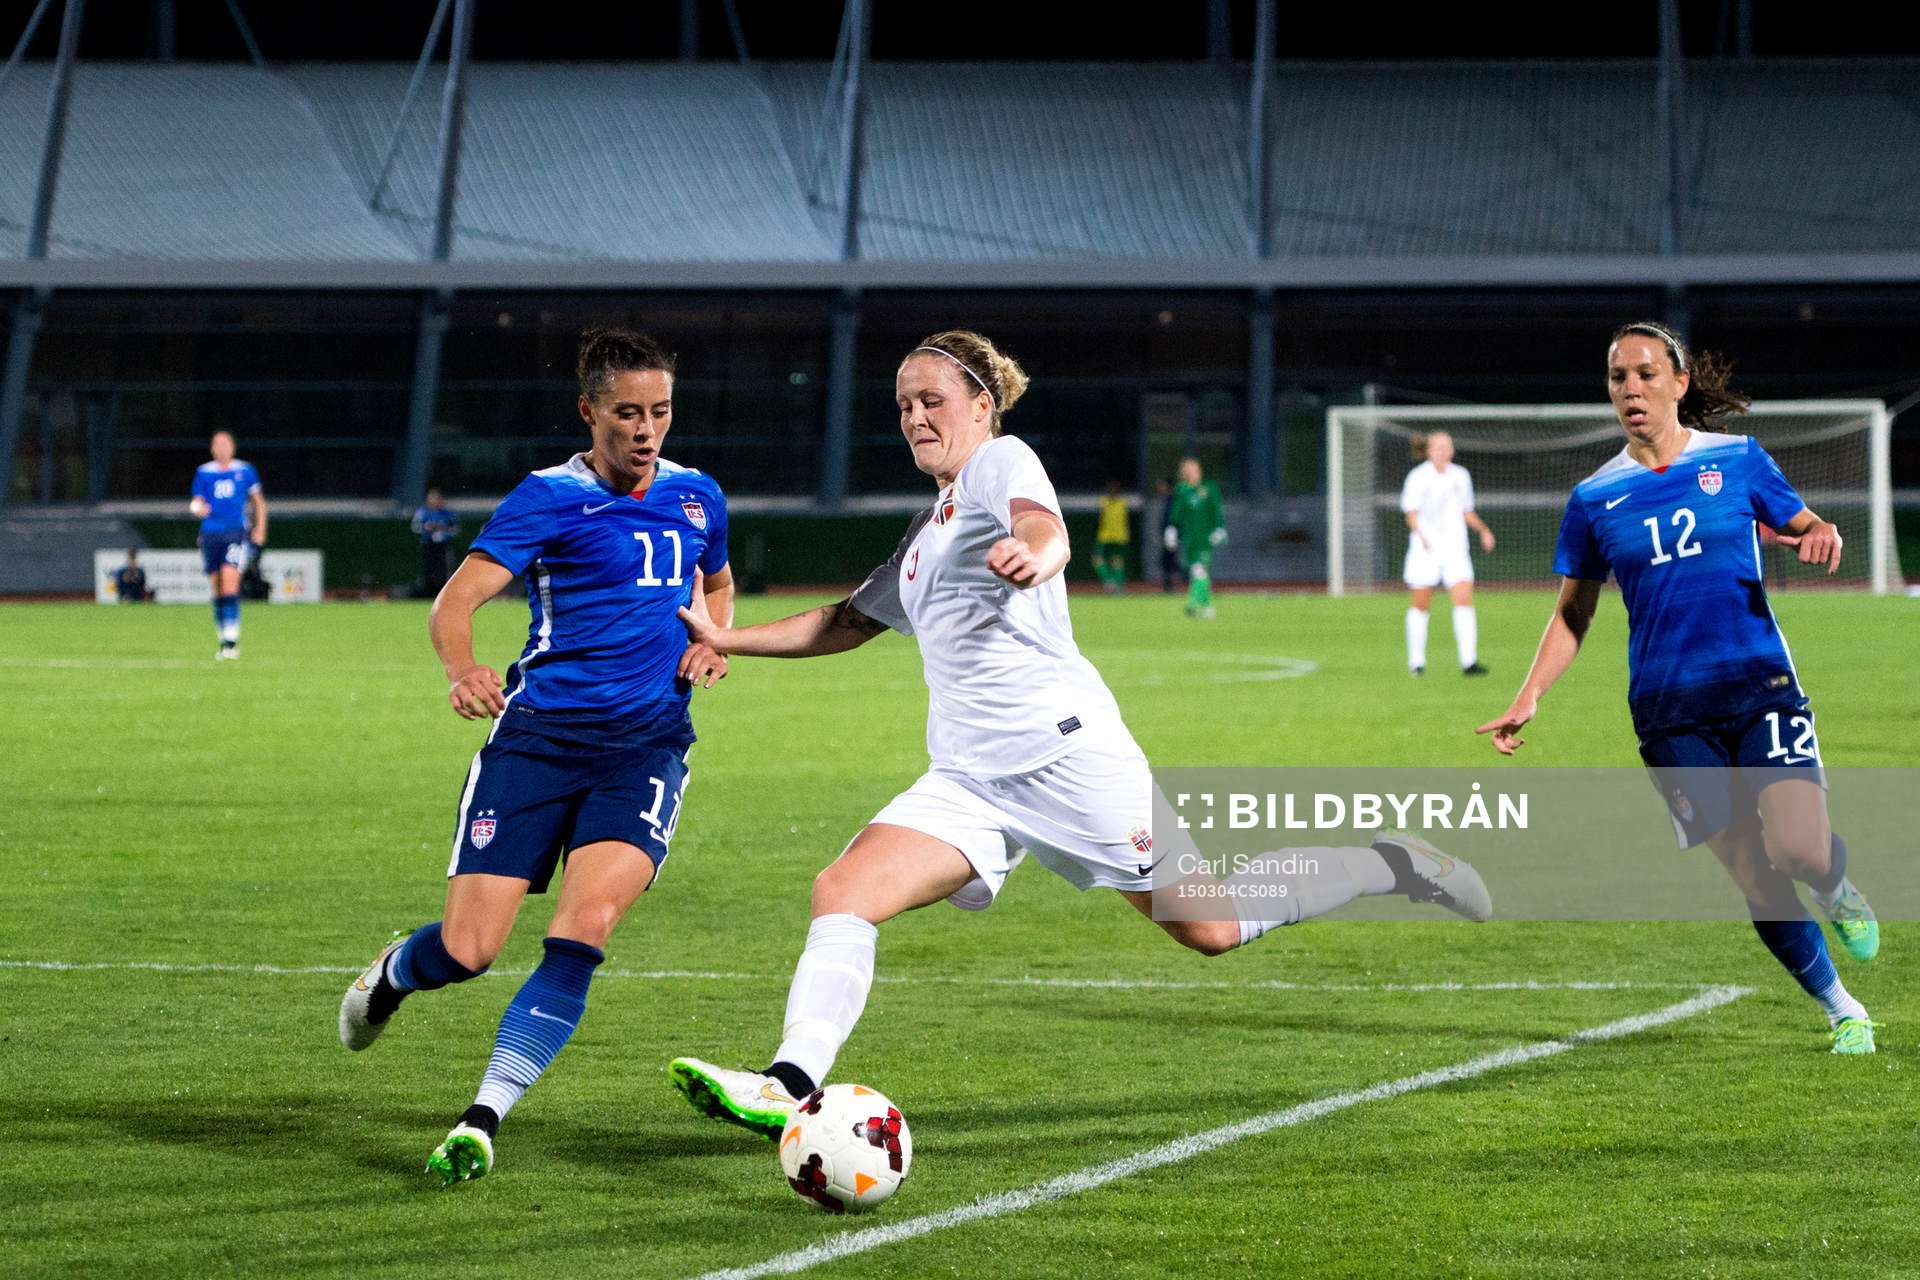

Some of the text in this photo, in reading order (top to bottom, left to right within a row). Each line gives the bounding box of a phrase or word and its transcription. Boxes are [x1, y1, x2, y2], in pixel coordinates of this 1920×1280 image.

[633, 529, 684, 587] 11
[1643, 507, 1703, 566] 12
[1764, 712, 1816, 760] 12
